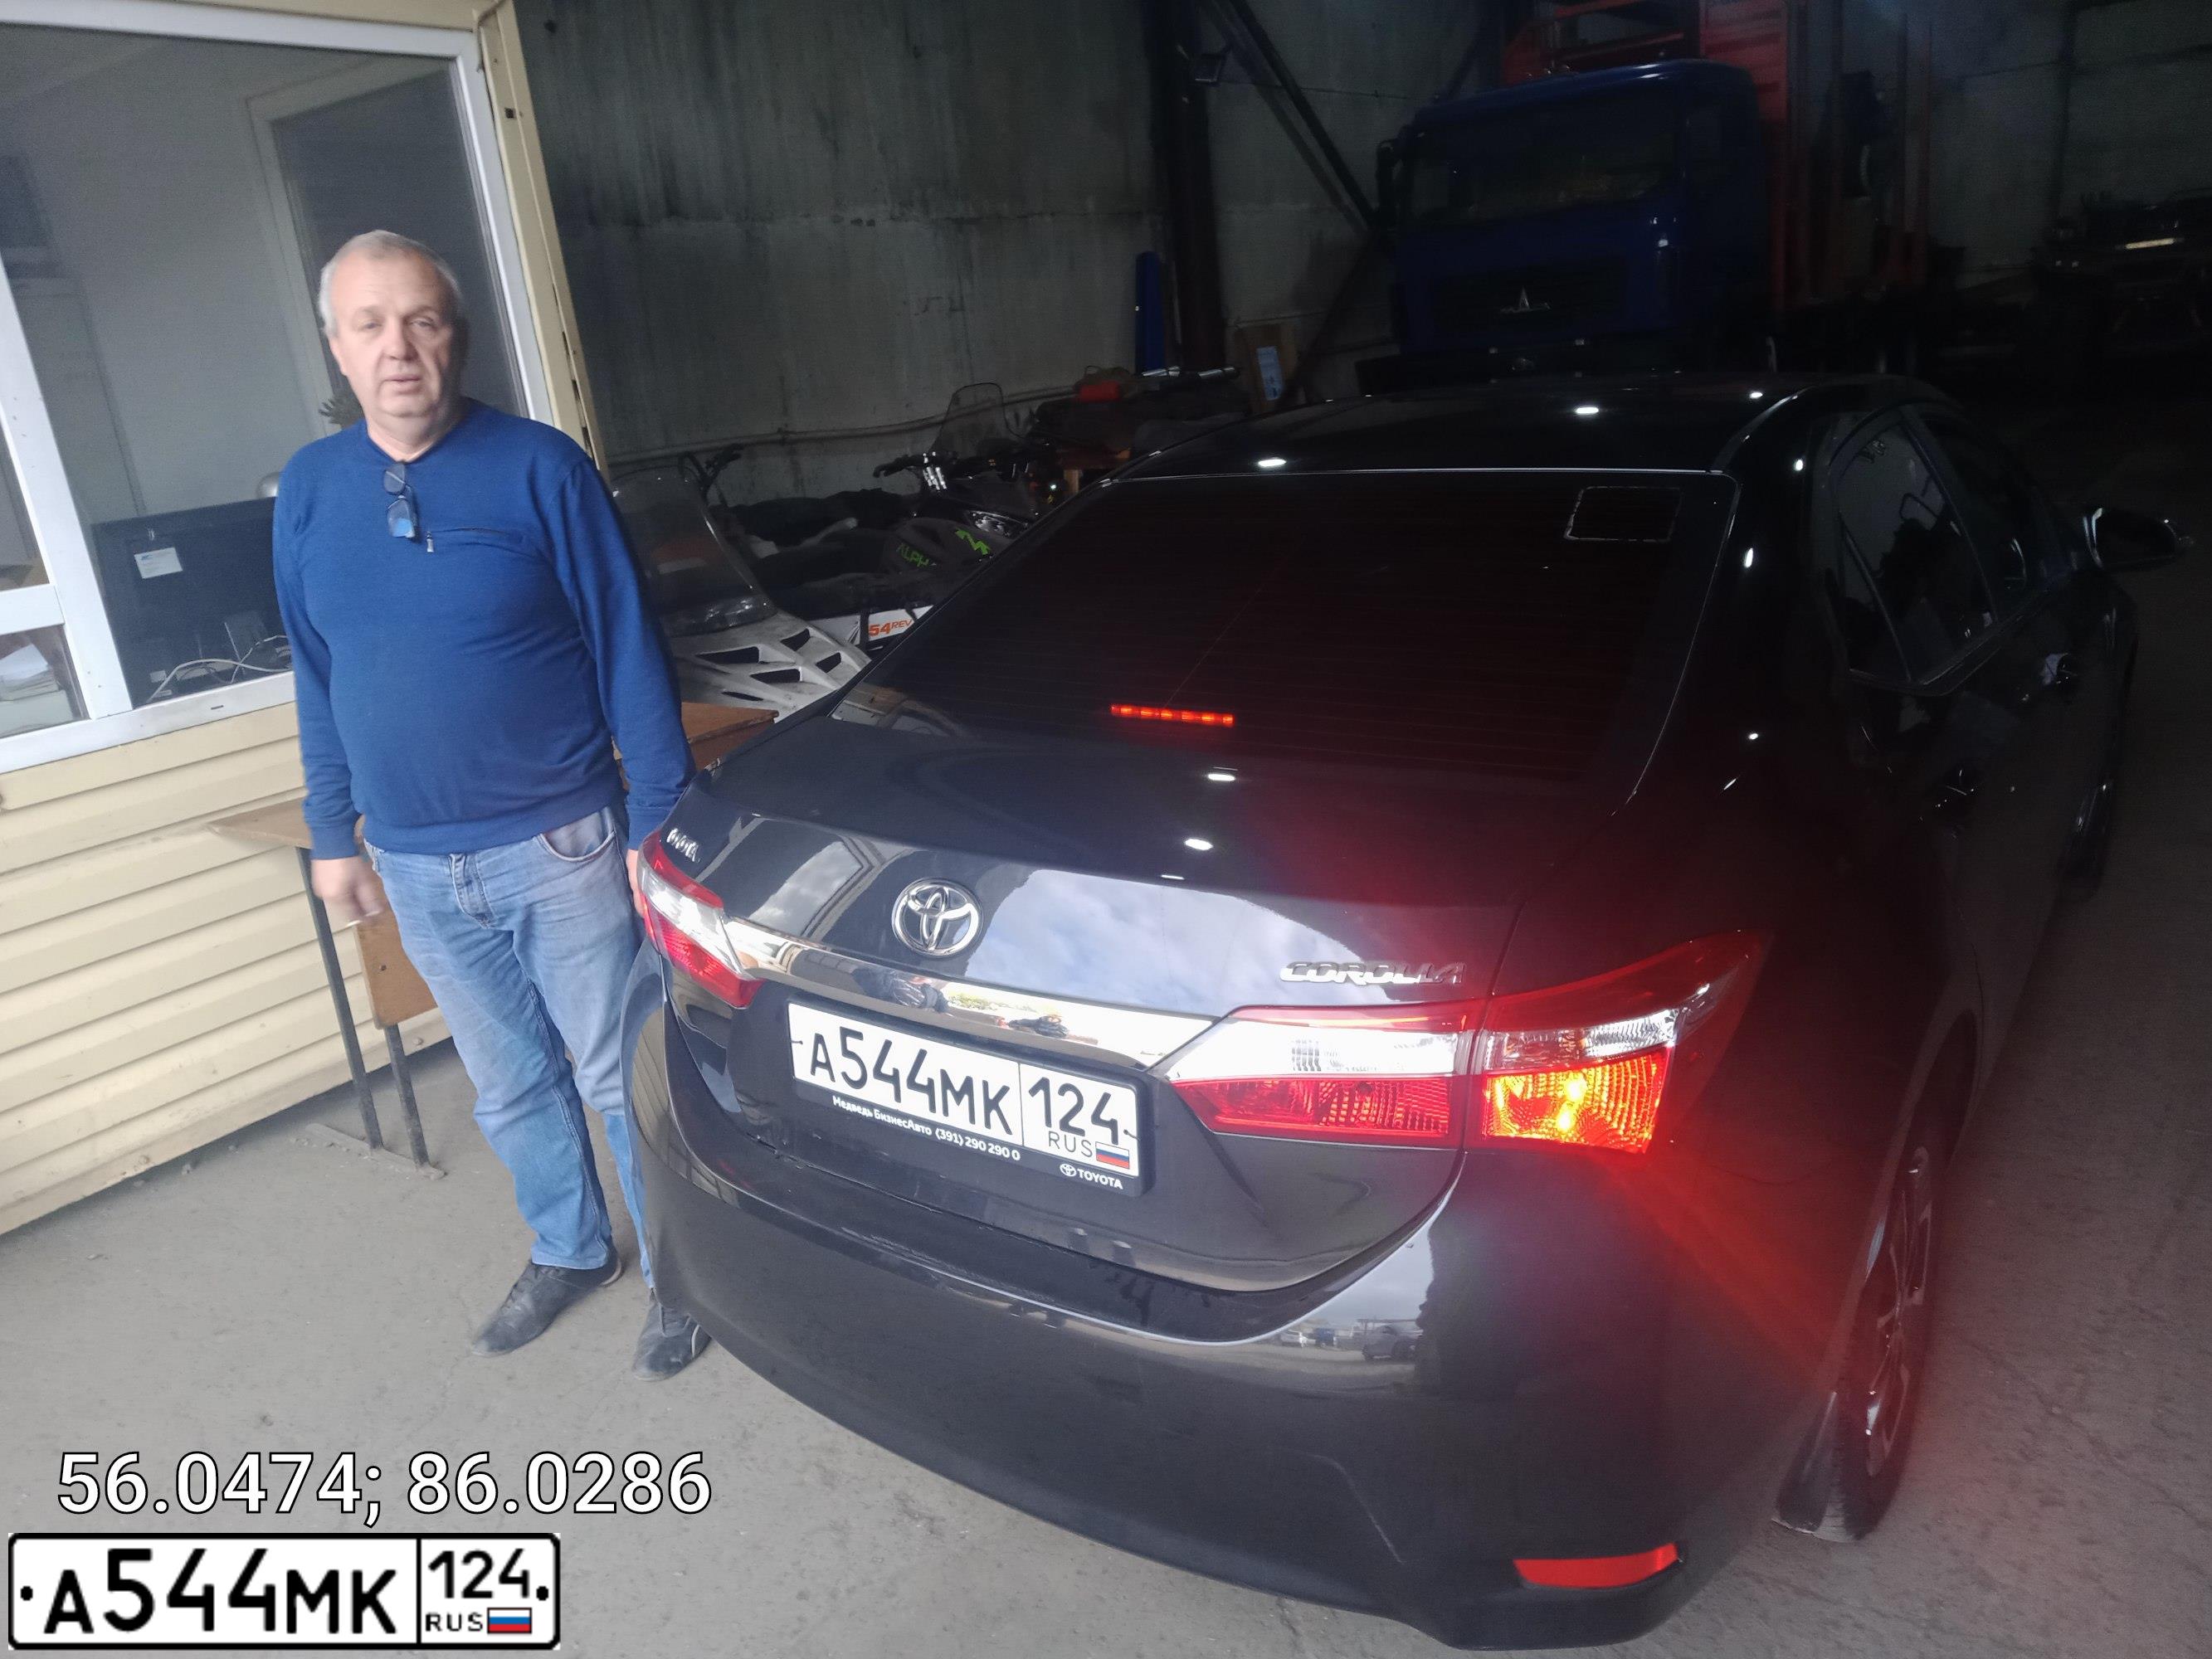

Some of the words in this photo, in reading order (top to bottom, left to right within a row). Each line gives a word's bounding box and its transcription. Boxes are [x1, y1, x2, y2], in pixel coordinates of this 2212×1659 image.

[1280, 961, 1465, 985] COROLLA
[1028, 1077, 1118, 1146] 124
[832, 1095, 873, 1118] Медведь
[935, 1126, 963, 1147] (391)
[965, 1136, 986, 1152] 290
[987, 1142, 1010, 1159] 290
[1011, 1149, 1021, 1161] 0
[1049, 1131, 1093, 1158] RUS
[1077, 1168, 1123, 1190] TOYOTA
